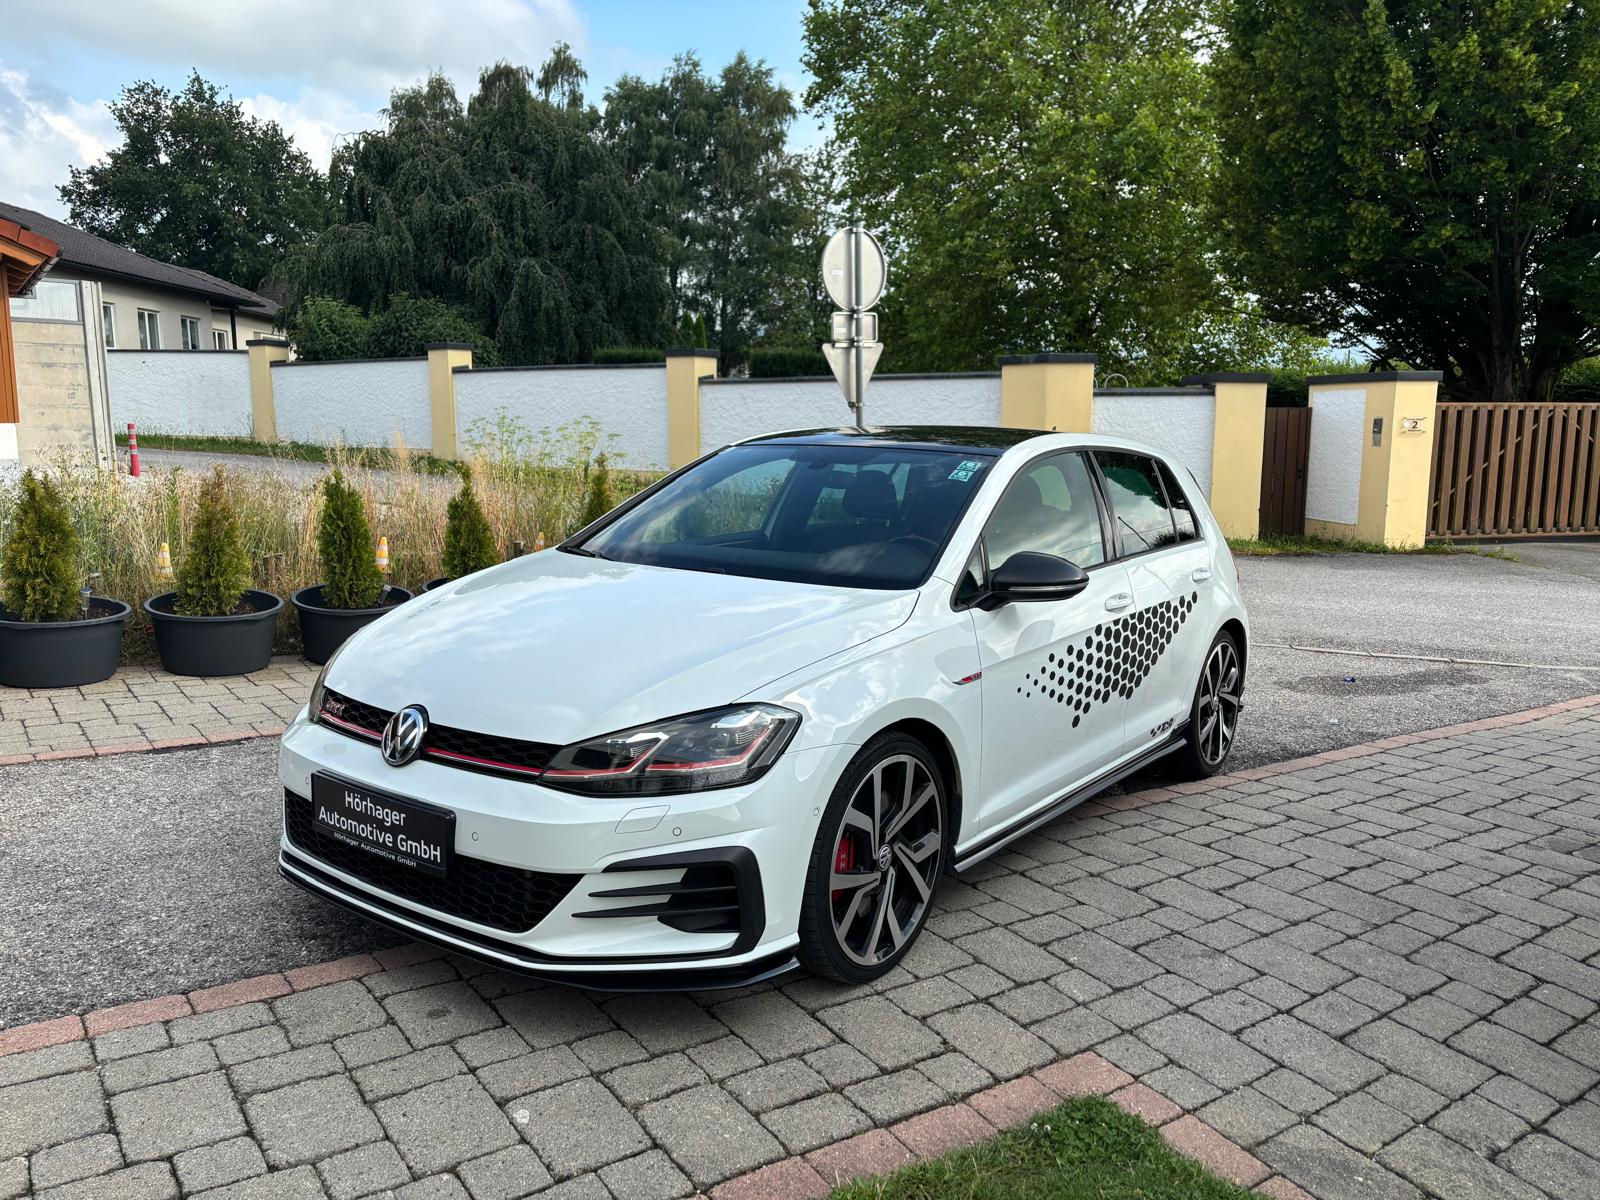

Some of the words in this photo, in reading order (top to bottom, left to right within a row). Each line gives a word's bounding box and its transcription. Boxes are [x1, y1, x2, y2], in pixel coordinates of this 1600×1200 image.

[1412, 420, 1418, 429] 2
[345, 790, 406, 826] Hörhager
[319, 806, 393, 847] Automotive
[397, 835, 441, 863] GmbH
[334, 831, 360, 847] Hörhager
[360, 843, 396, 860] Automotive
[396, 854, 417, 868] GmbH
